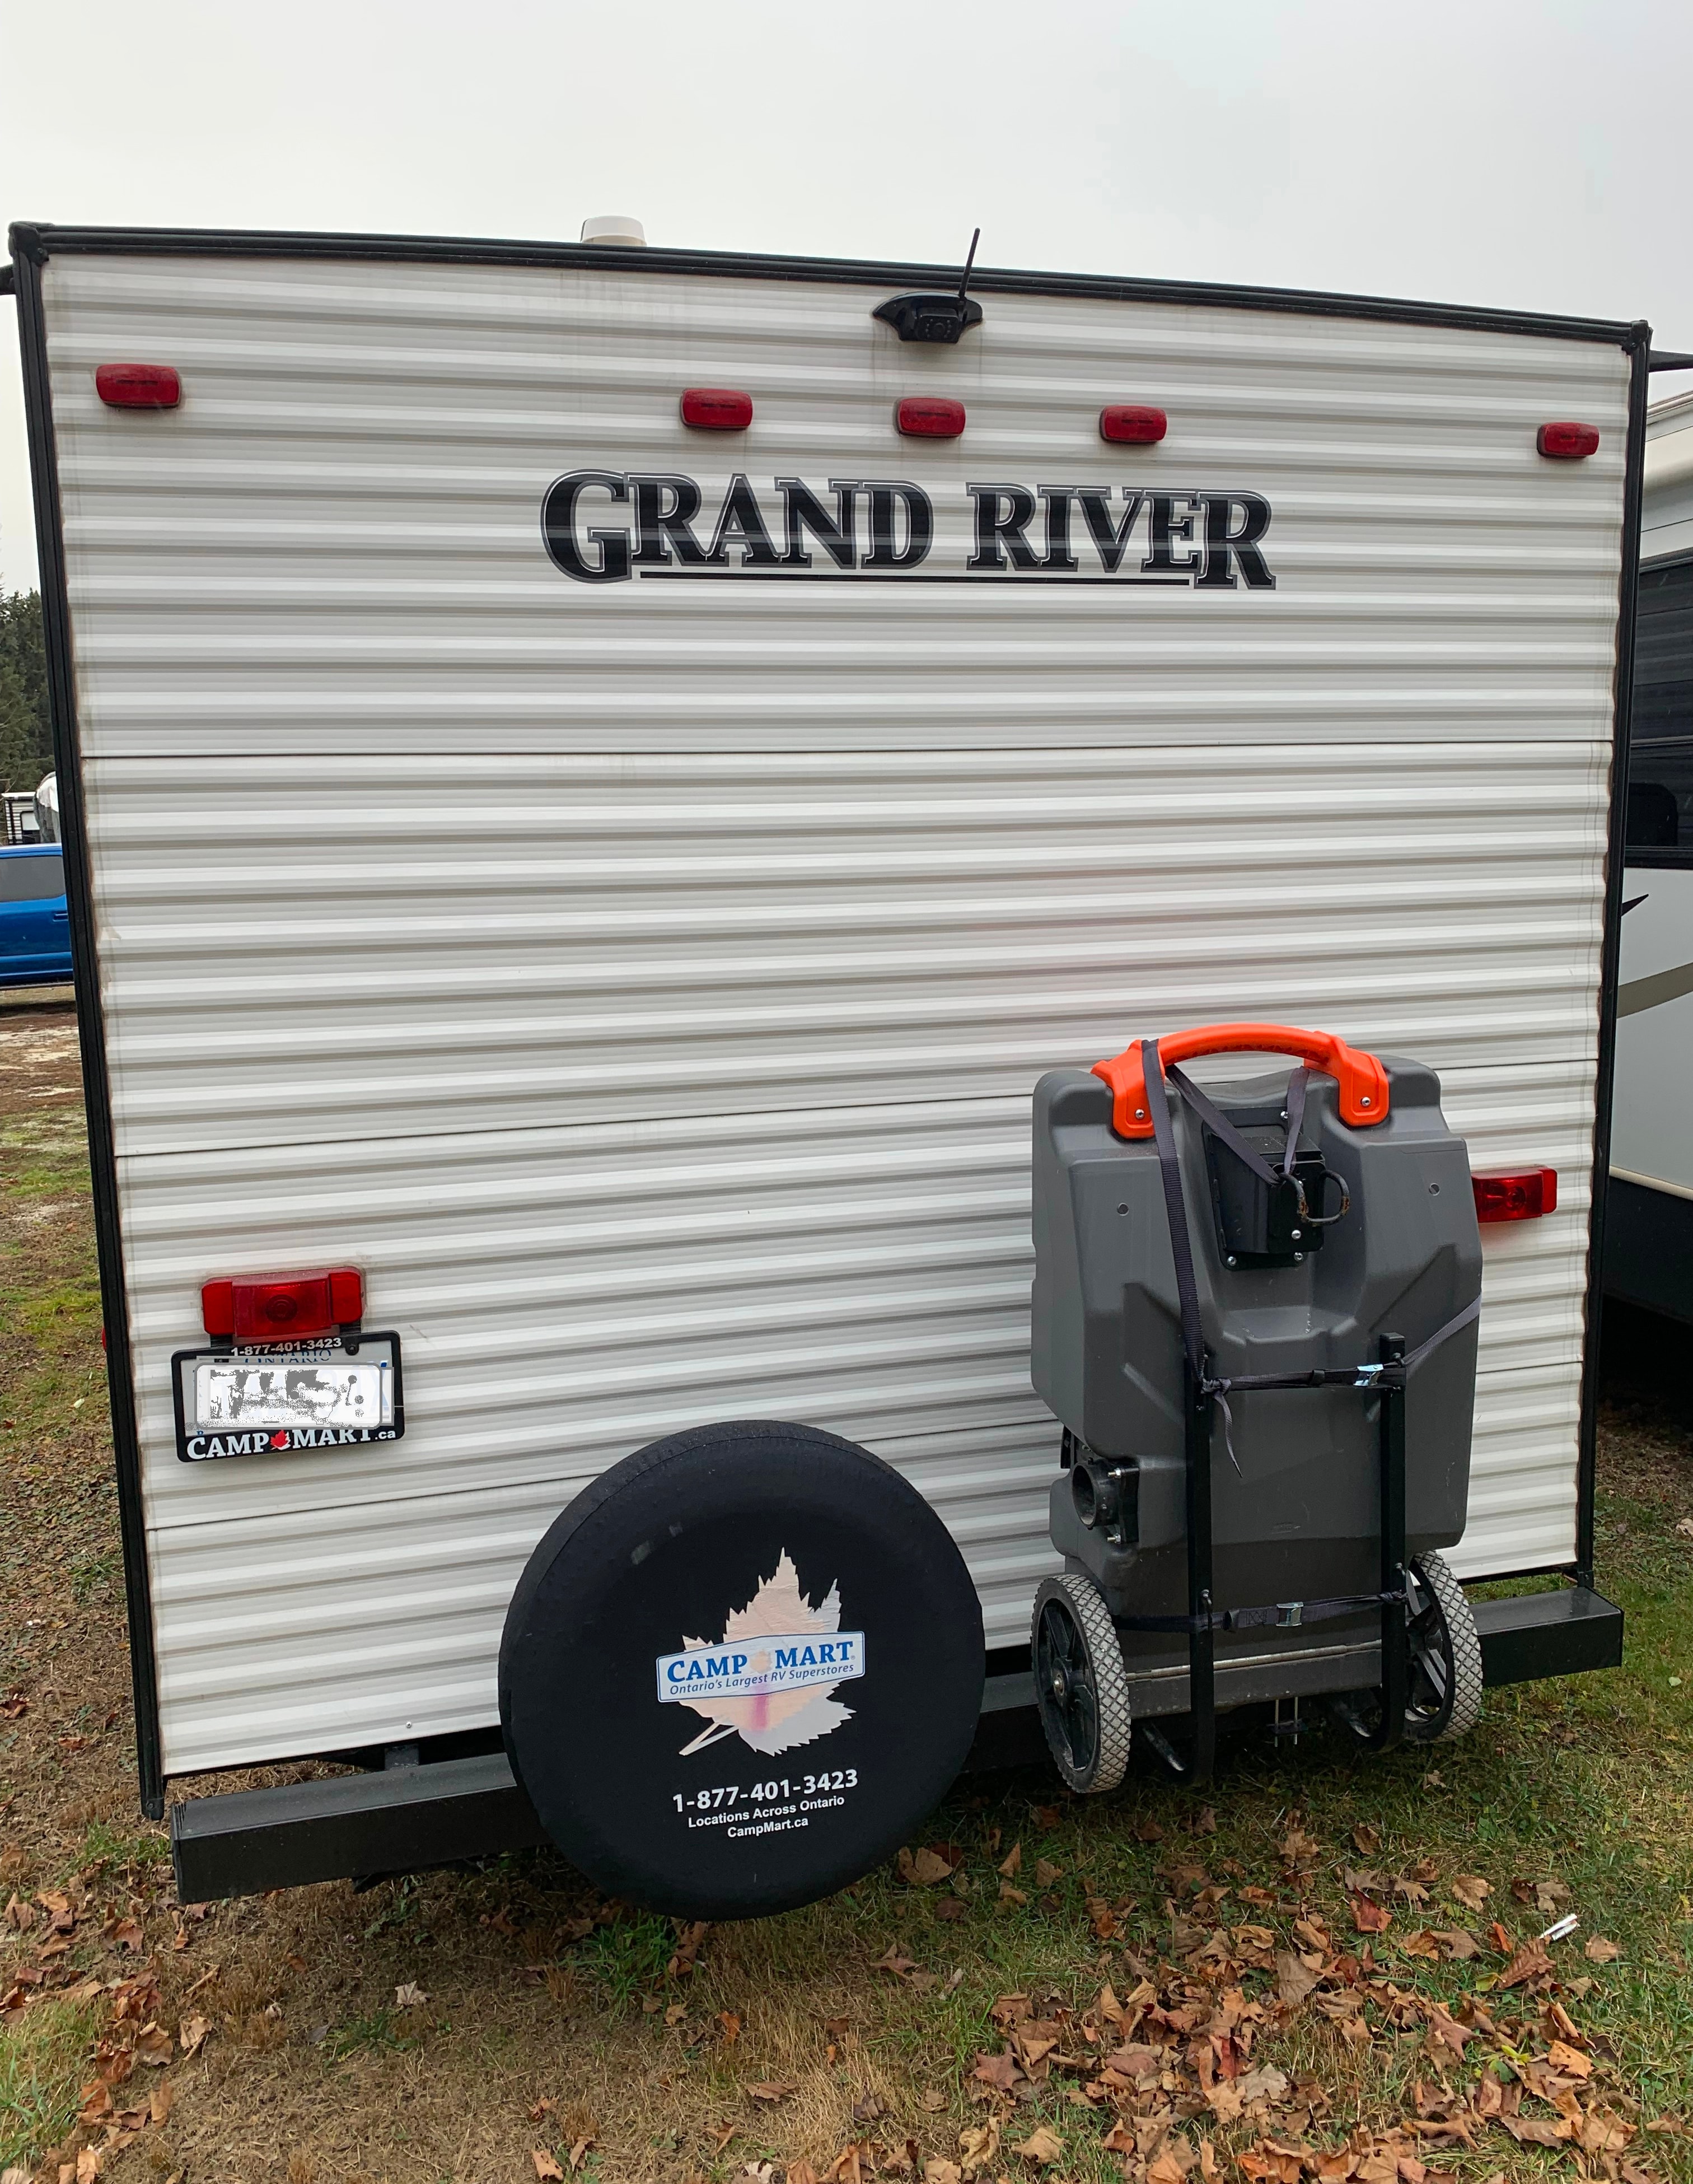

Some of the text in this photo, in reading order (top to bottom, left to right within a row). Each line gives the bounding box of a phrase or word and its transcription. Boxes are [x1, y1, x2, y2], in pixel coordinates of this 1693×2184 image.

[541, 469, 1276, 589] GRAND RIVER
[231, 1337, 342, 1356] 1-877-401-3423
[187, 1432, 269, 1459] CAMP
[667, 1654, 747, 1683] CAMP
[670, 1664, 854, 1695] Ontario's Largest RV Superstores
[673, 1769, 858, 1812] 1-877-401-3423
[688, 1795, 845, 1828] Locations Across Ontario
[728, 1818, 808, 1837] CampMart.ca
